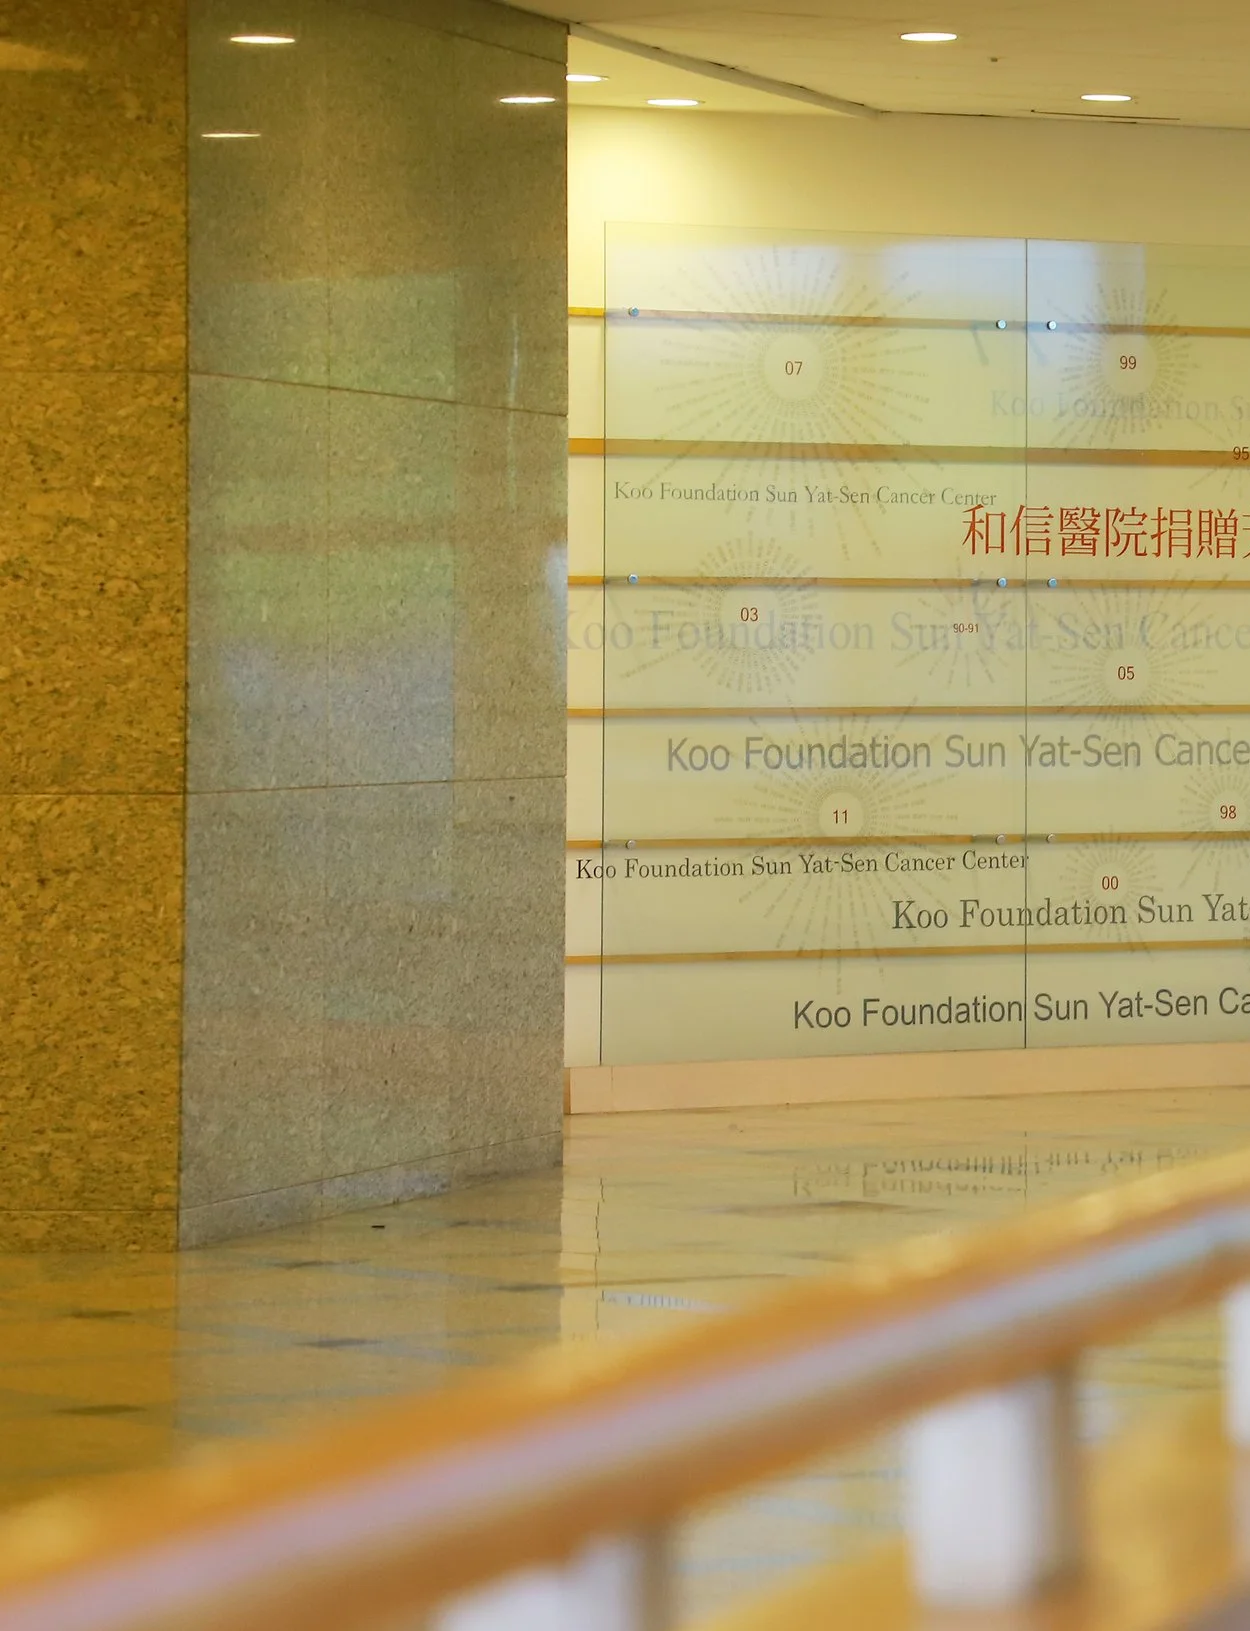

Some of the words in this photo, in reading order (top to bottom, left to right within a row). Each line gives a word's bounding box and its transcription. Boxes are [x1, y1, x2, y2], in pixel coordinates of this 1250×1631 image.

[784, 360, 803, 376] 07
[1119, 355, 1137, 370] 99
[1232, 446, 1250, 461] 95
[614, 481, 653, 500] Koo
[660, 481, 759, 501] Foundation
[766, 484, 797, 503] Sun
[804, 485, 870, 504] Yat-Sen
[876, 486, 936, 505] Cancer
[941, 487, 997, 507] Center
[740, 606, 759, 622] 03
[1117, 666, 1135, 680] 05
[667, 737, 731, 772] Koo
[745, 735, 931, 770] Foundation
[944, 734, 1006, 769] Sun
[1020, 733, 1141, 768] Yat-Sen
[832, 809, 849, 824] 11
[1219, 805, 1237, 820] 98
[576, 858, 617, 880] Koo
[624, 857, 744, 879] Foundation
[751, 855, 792, 876] Sun
[799, 853, 878, 874] Yat-Sen
[885, 851, 956, 873] Cancer
[962, 850, 1029, 872] Center
[1101, 876, 1119, 891] 00
[892, 900, 949, 930] Koo
[960, 897, 1128, 929] Foundation
[1137, 895, 1194, 925] Sun
[794, 1000, 852, 1030] Koo
[863, 996, 1022, 1029] Foundation
[1034, 993, 1088, 1022] Sun
[1099, 989, 1208, 1020] Yat-Sen
